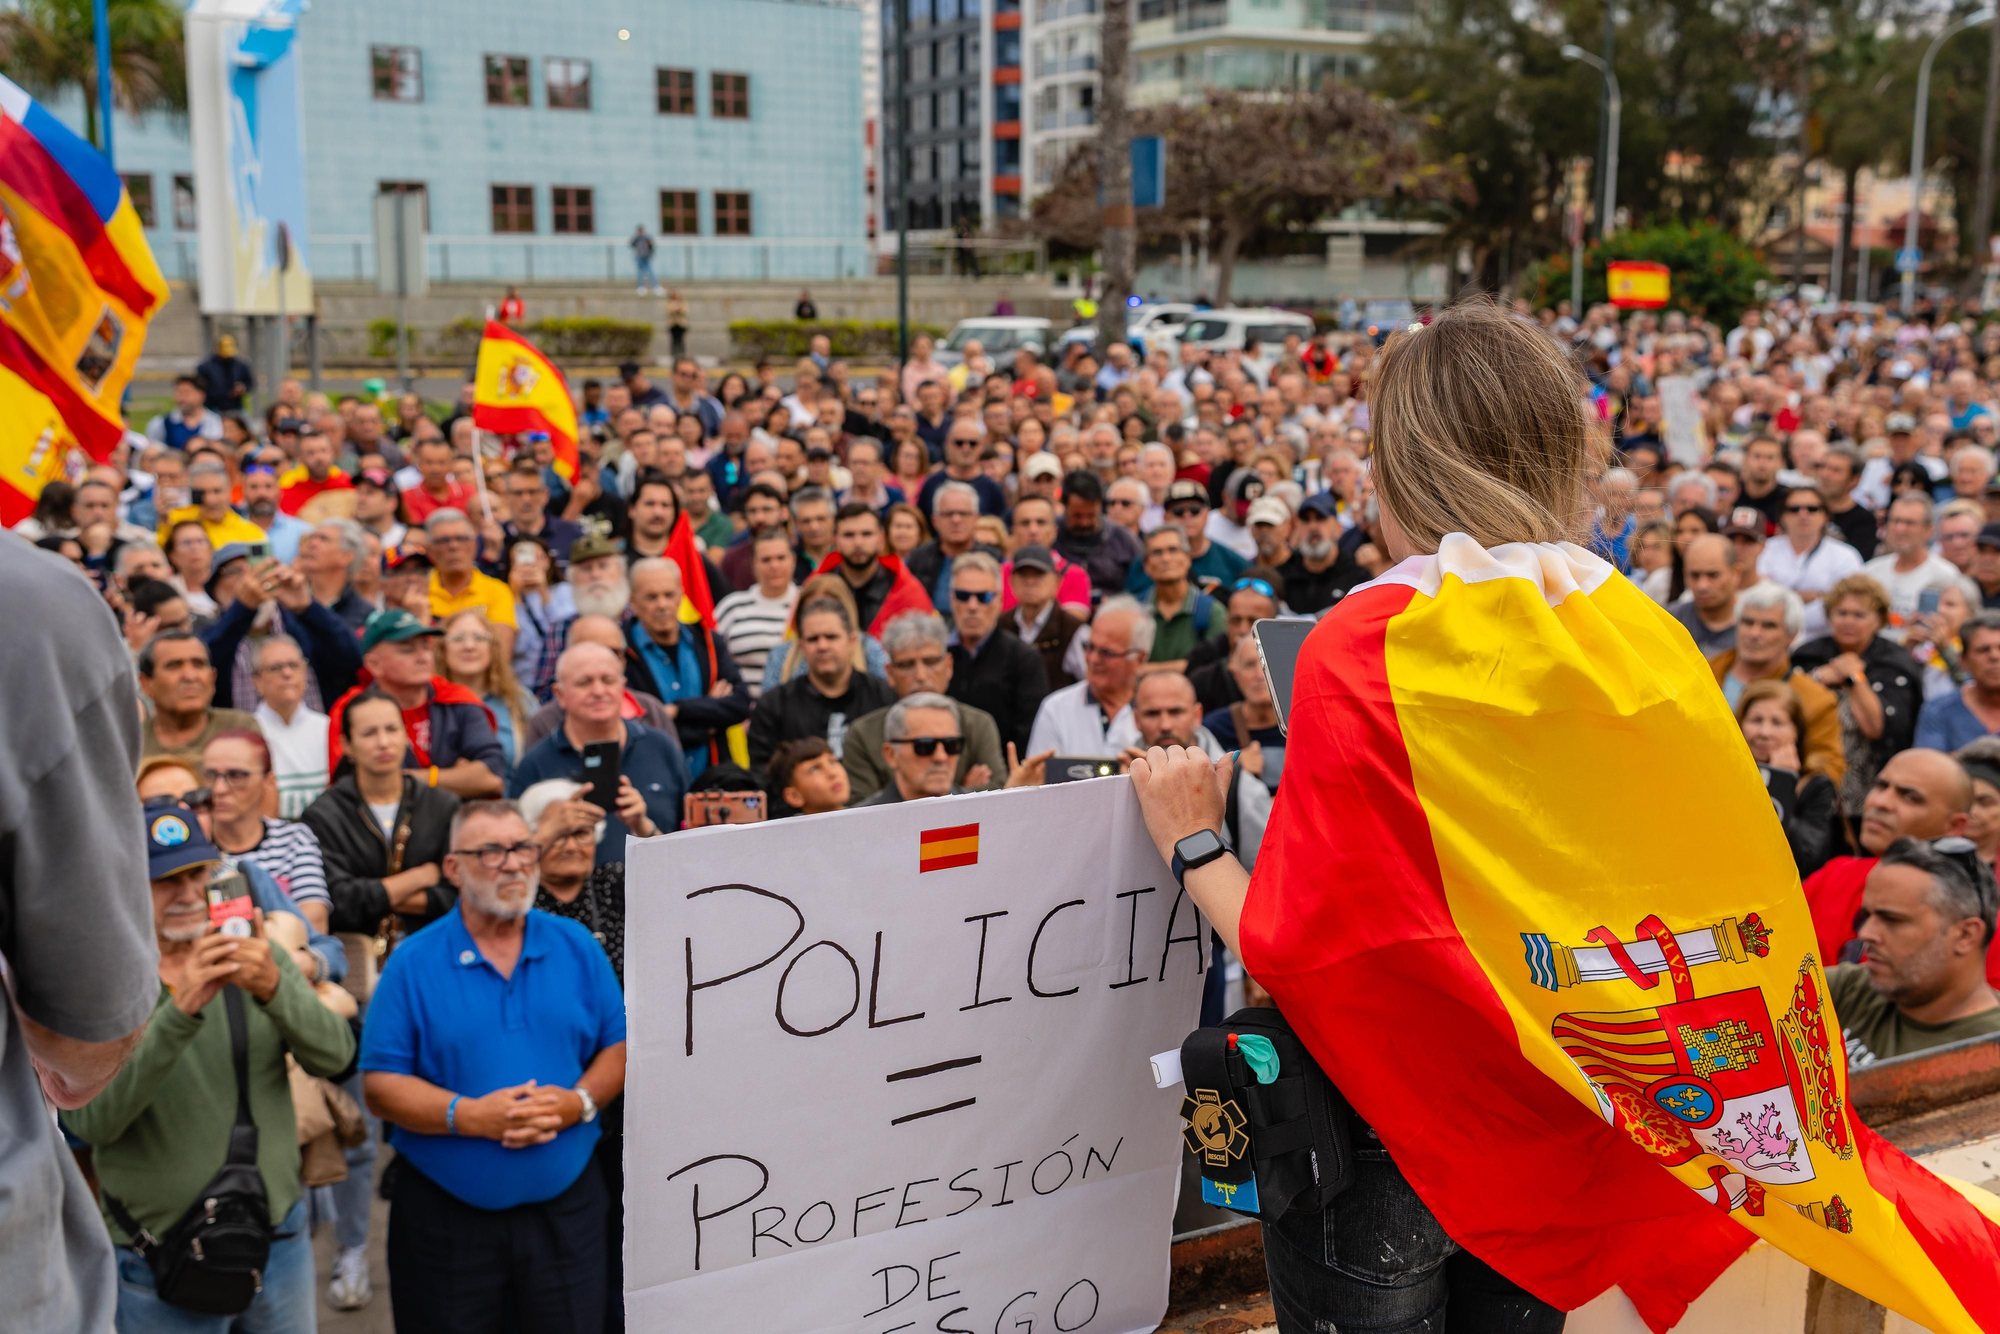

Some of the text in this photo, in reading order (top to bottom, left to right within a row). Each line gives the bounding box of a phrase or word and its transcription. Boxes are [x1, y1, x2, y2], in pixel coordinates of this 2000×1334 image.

[685, 883, 1204, 1057] POLICIA
[1656, 927, 1689, 984] PLVS
[1199, 1093, 1217, 1102] RHINO
[1207, 1153, 1226, 1162] RESCUE
[666, 1133, 1124, 1271] PROFESIÓN
[863, 1250, 961, 1318] DE
